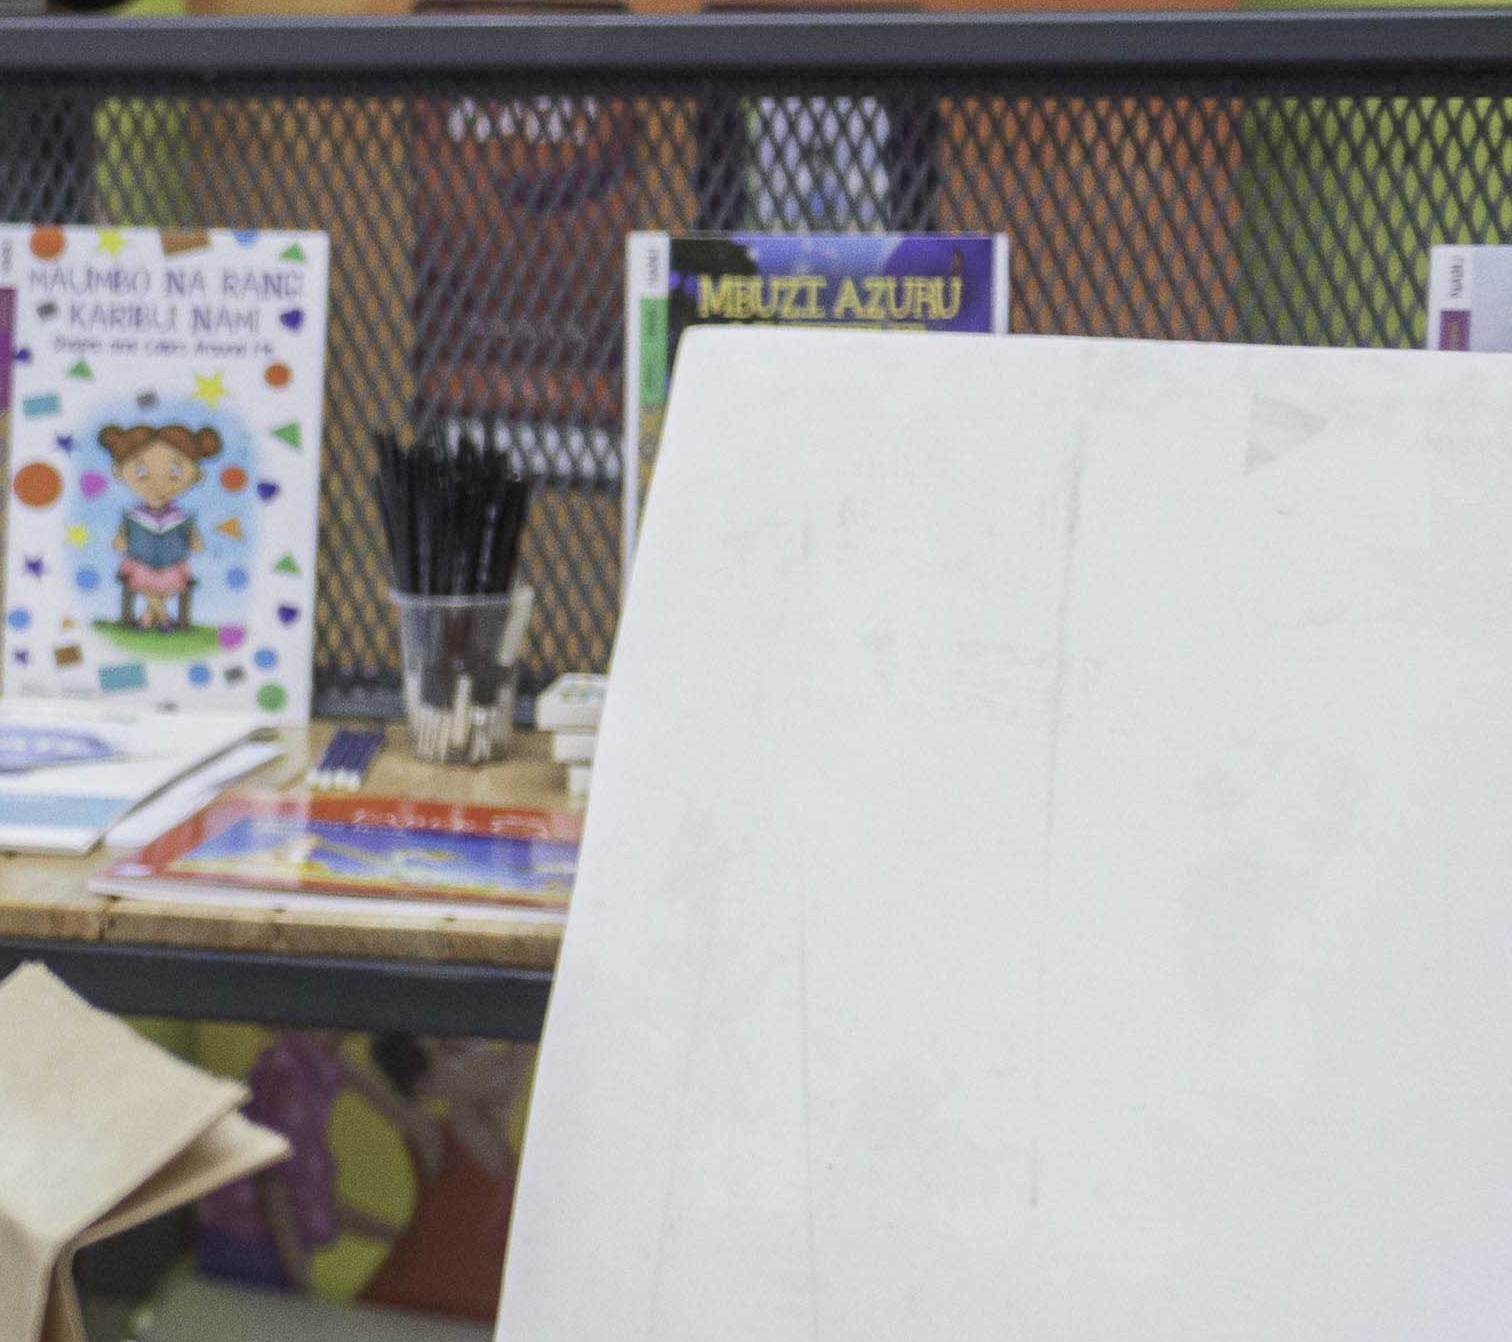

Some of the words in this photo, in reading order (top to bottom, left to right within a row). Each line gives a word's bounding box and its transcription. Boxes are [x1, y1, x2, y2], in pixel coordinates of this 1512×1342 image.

[28, 265, 152, 297] MAUMBO
[166, 268, 207, 298] NA
[696, 274, 828, 321] MBUZI
[833, 275, 964, 322] AZURU
[69, 303, 177, 333] KARIBU
[192, 304, 262, 334] NAMI
